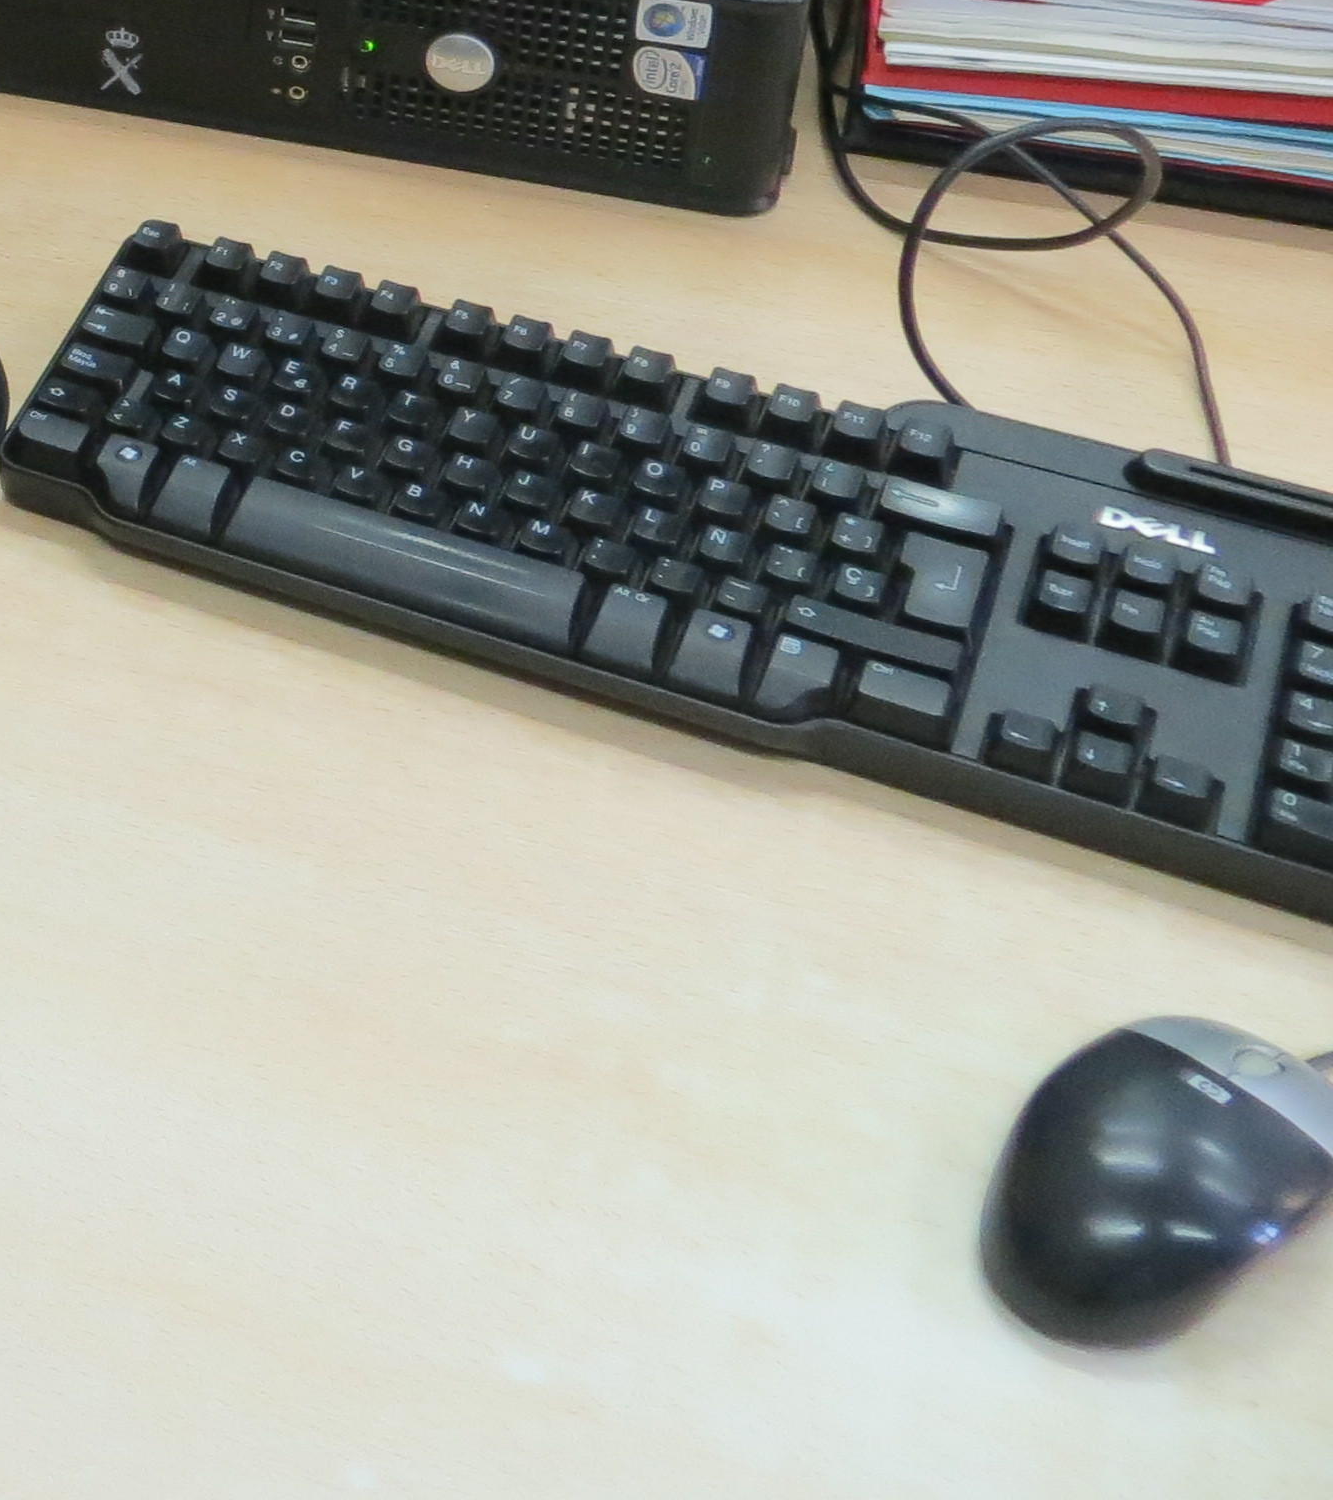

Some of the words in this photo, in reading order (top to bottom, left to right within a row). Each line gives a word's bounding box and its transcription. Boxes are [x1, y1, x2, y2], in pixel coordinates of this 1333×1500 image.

[175, 331, 191, 344] Q
[233, 346, 252, 359] W
[285, 361, 300, 373] E
[168, 374, 182, 386] A
[341, 377, 357, 390] R
[224, 389, 237, 401] S
[403, 393, 416, 405] T
[280, 405, 295, 417] D
[461, 410, 476, 422] Y
[173, 416, 190, 428] Z
[337, 421, 352, 432] F
[231, 432, 246, 445] X
[521, 427, 536, 440] U
[397, 439, 413, 452] G
[289, 451, 305, 463] C
[457, 457, 473, 469] H
[350, 466, 364, 480] V
[647, 463, 663, 476] O
[518, 474, 531, 486] J
[710, 481, 725, 491] P
[407, 485, 422, 498] B
[581, 492, 597, 505] K
[468, 503, 485, 517] N
[644, 510, 656, 523] L
[532, 521, 550, 536] M
[1096, 505, 1217, 555] DELL
